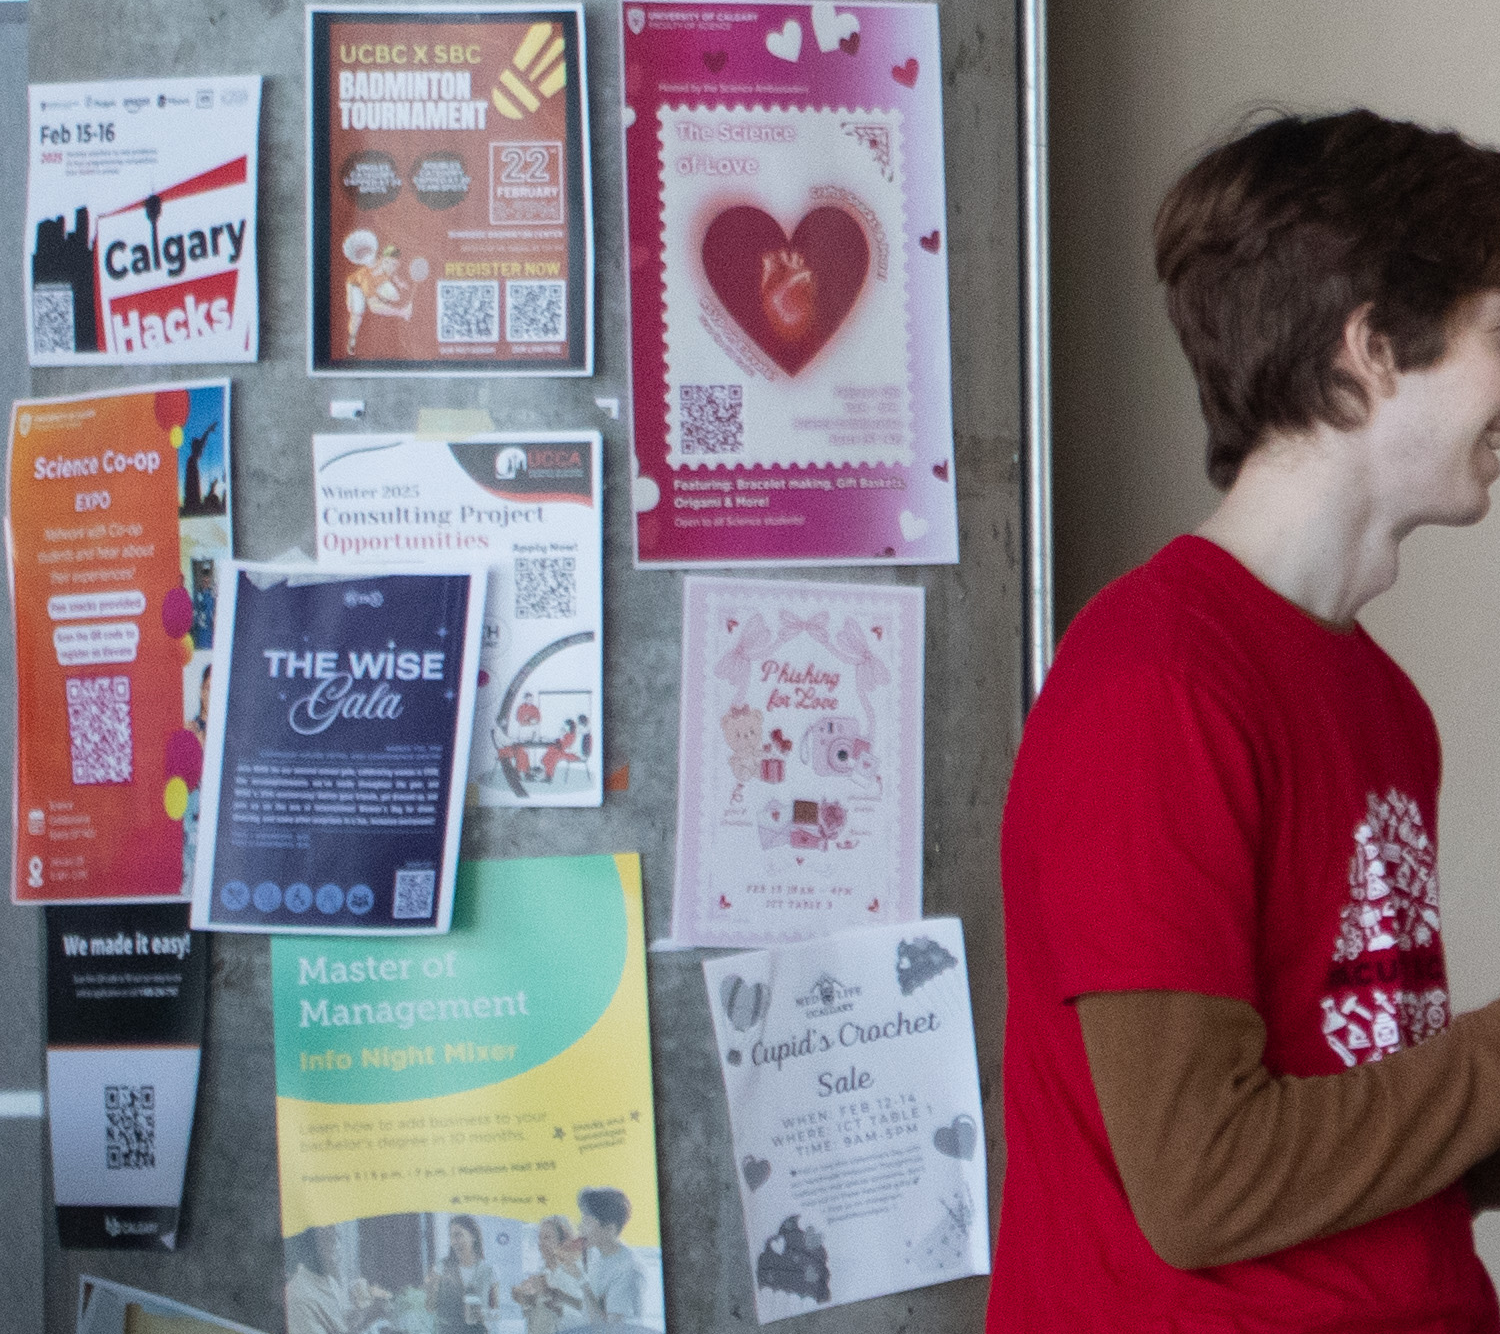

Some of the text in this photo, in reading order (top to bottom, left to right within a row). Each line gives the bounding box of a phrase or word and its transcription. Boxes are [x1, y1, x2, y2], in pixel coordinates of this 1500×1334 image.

[340, 44, 482, 64] UCBC X SBC
[339, 70, 471, 100] BADMINTON
[339, 100, 488, 130] TOURNAMENT
[40, 122, 116, 145] Feb 15-16
[676, 121, 797, 142] The Science
[500, 146, 551, 183] 22
[677, 155, 760, 176] of Love
[496, 186, 559, 199] FEBRUARY
[104, 213, 248, 281] Calgary
[444, 260, 561, 278] REGISTER NOW
[112, 293, 233, 353] Hacks
[33, 449, 161, 480] Science Co-op
[321, 484, 421, 500] Winter 2025
[736, 478, 786, 490] Bracelet
[74, 490, 112, 513] EXPO
[673, 496, 722, 510] Origami
[322, 505, 545, 528] Consulting Project
[322, 532, 490, 555] Opportunities
[263, 648, 340, 679] THE
[760, 659, 841, 692] Phishing
[289, 671, 405, 735] Gala
[766, 686, 839, 712] for Love
[62, 930, 191, 960] We made it easy!
[298, 949, 458, 986] Master of
[299, 990, 531, 1030] Management
[751, 1011, 941, 1071] Cupid's Crochet
[300, 1042, 518, 1072] Info Night Mixer
[817, 1065, 875, 1098] Sale
[396, 1116, 426, 1131] add
[429, 1113, 490, 1129] business
[513, 1110, 548, 1129] your
[838, 1101, 870, 1117] FEB
[869, 1107, 919, 1126] TABLE
[377, 1135, 429, 1153] degree
